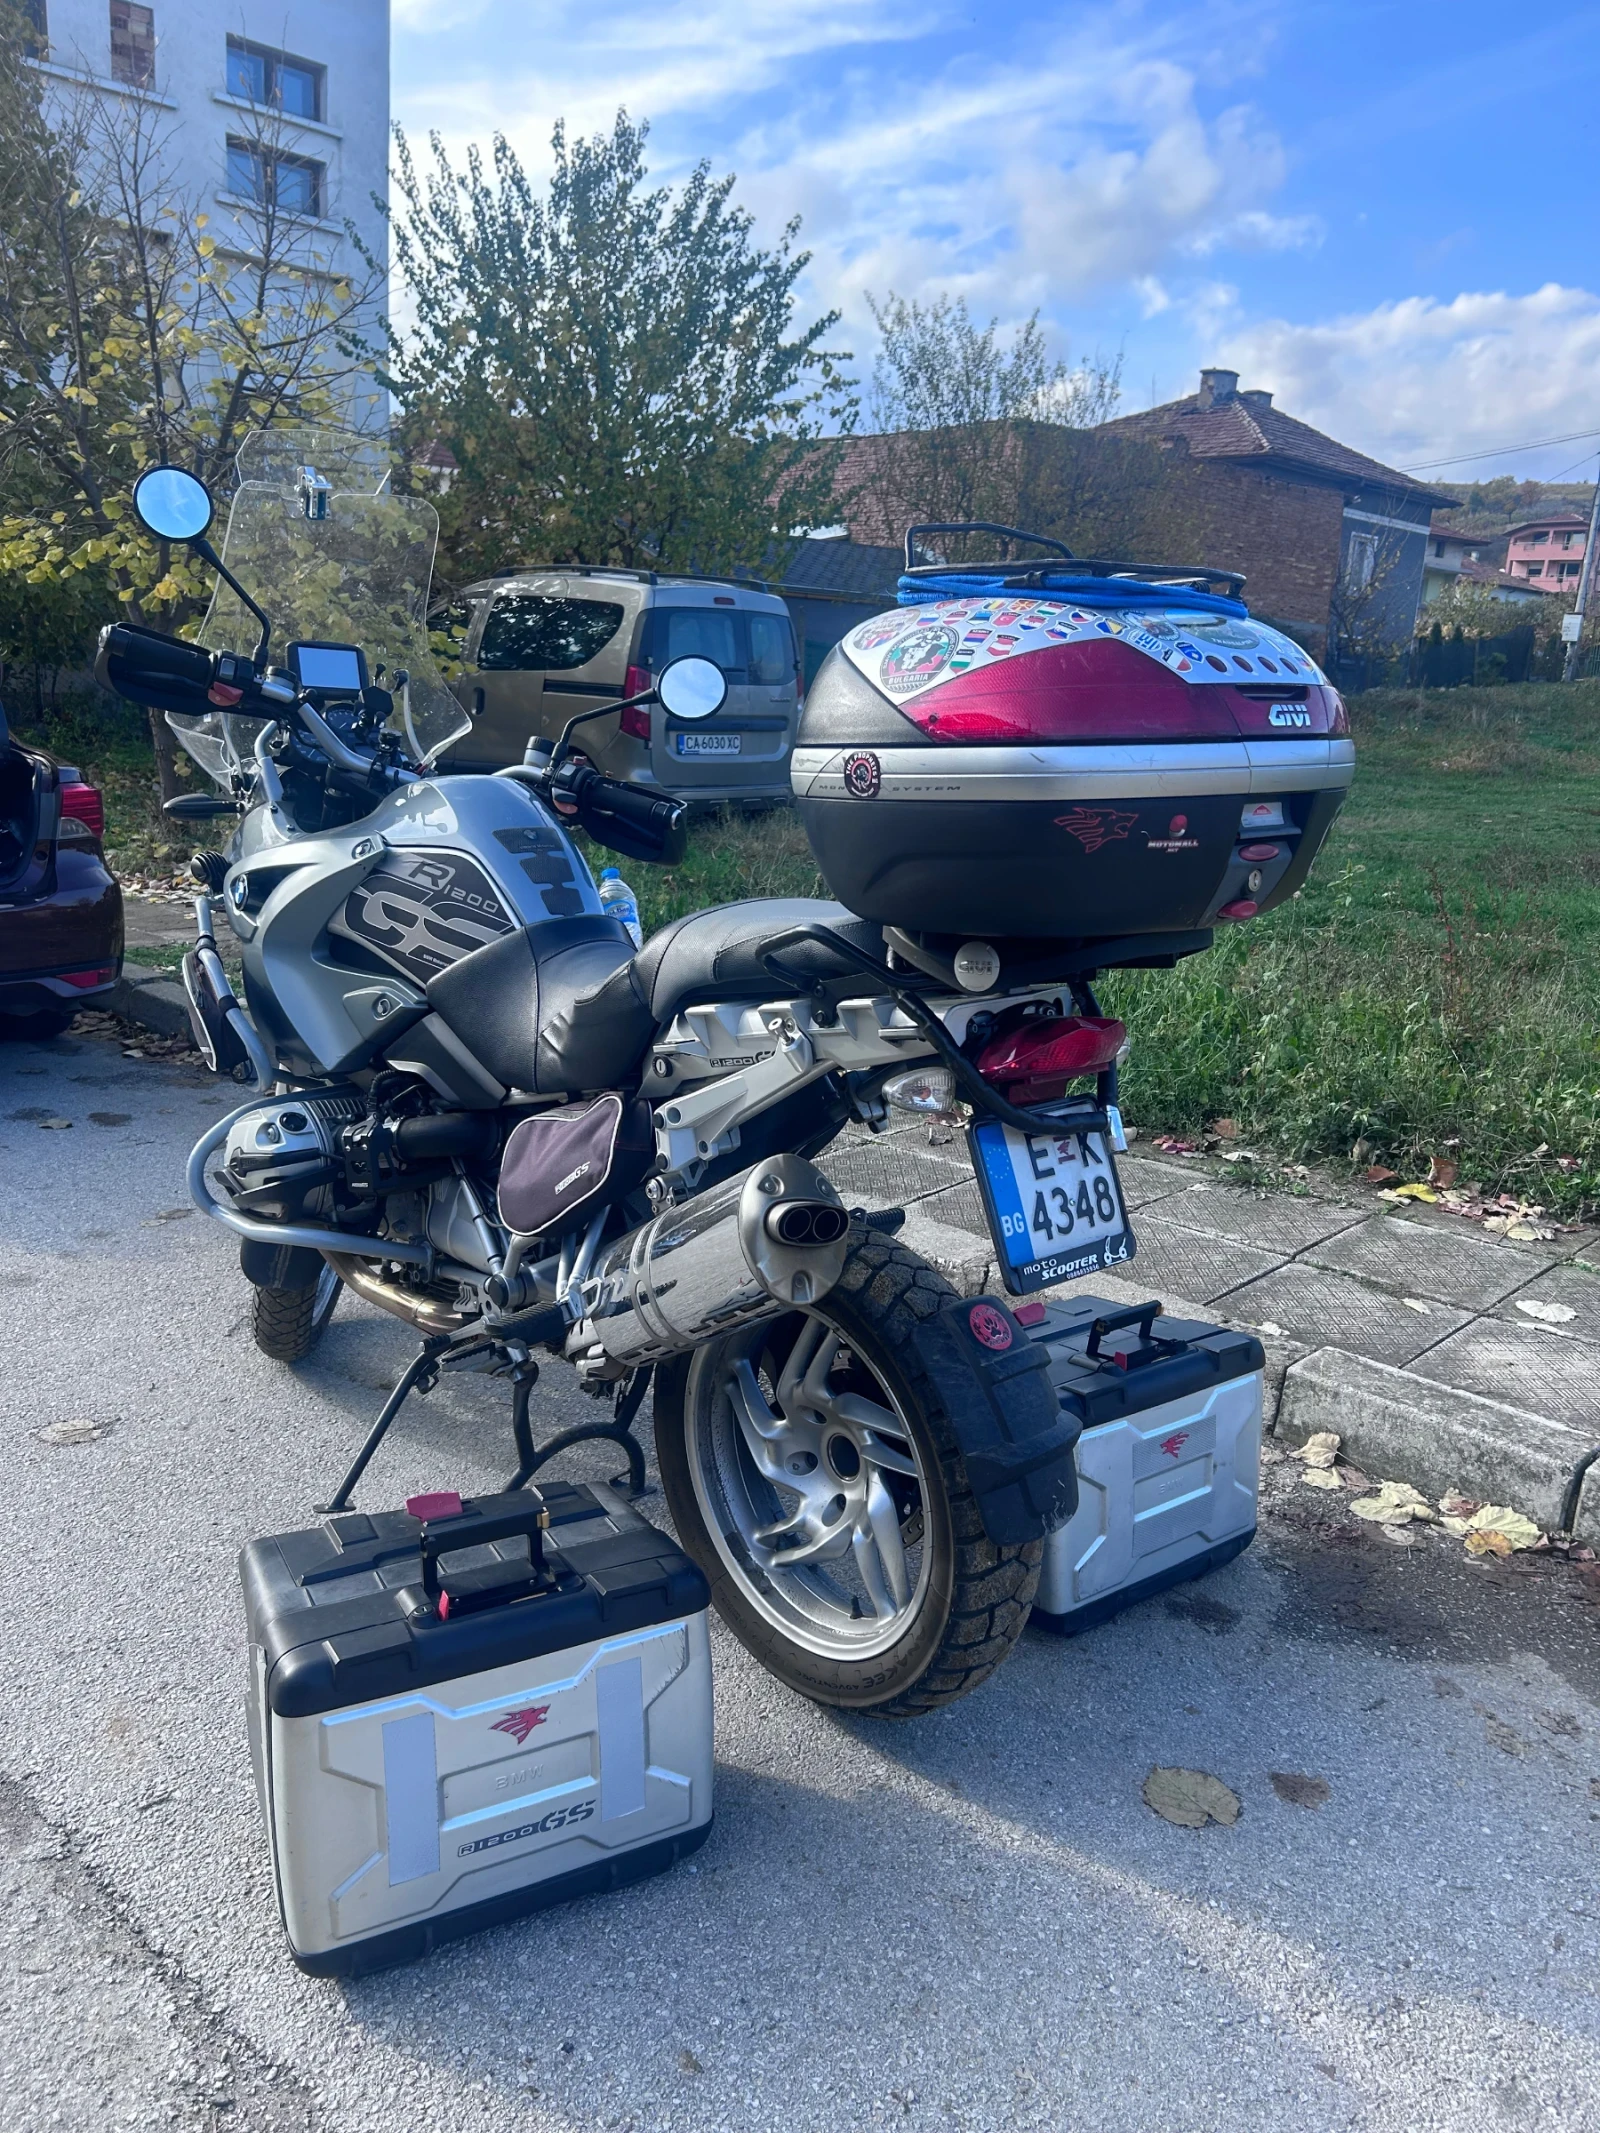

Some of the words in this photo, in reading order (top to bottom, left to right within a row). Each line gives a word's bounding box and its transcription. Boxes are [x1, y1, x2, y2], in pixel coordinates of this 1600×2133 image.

[888, 674, 929, 685] BULGARIA
[1269, 704, 1311, 727] GIVI
[686, 736, 700, 750] CA
[702, 736, 726, 750] 6030
[727, 736, 740, 750] XC
[1033, 1176, 1115, 1241] 4348
[1001, 1212, 1025, 1238] BG
[1023, 1258, 1057, 1276] moto
[1041, 1254, 1098, 1281] SCOOTER
[495, 1765, 544, 1789] BMW
